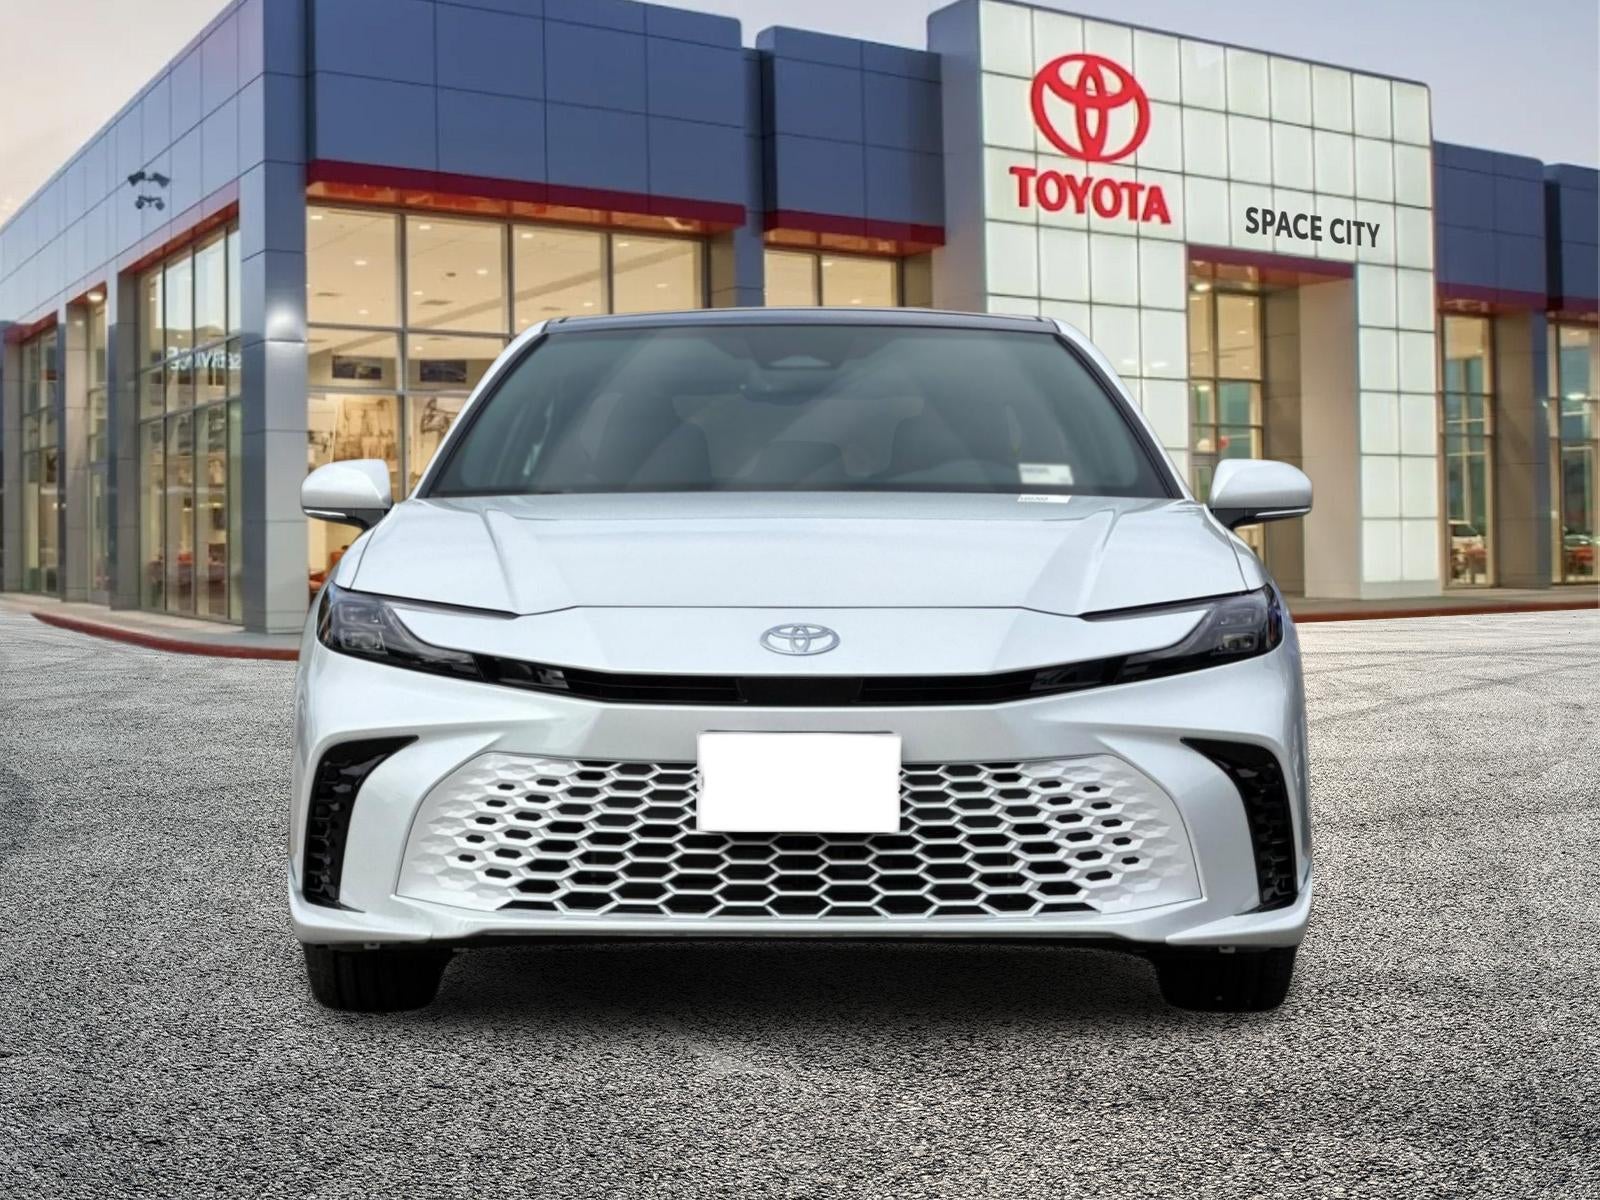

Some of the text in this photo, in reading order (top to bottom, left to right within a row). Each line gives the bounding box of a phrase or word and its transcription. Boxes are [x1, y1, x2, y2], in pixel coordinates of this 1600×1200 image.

[1009, 166, 1171, 224] TOYOTA
[1245, 206, 1380, 248] SPACE CITY
